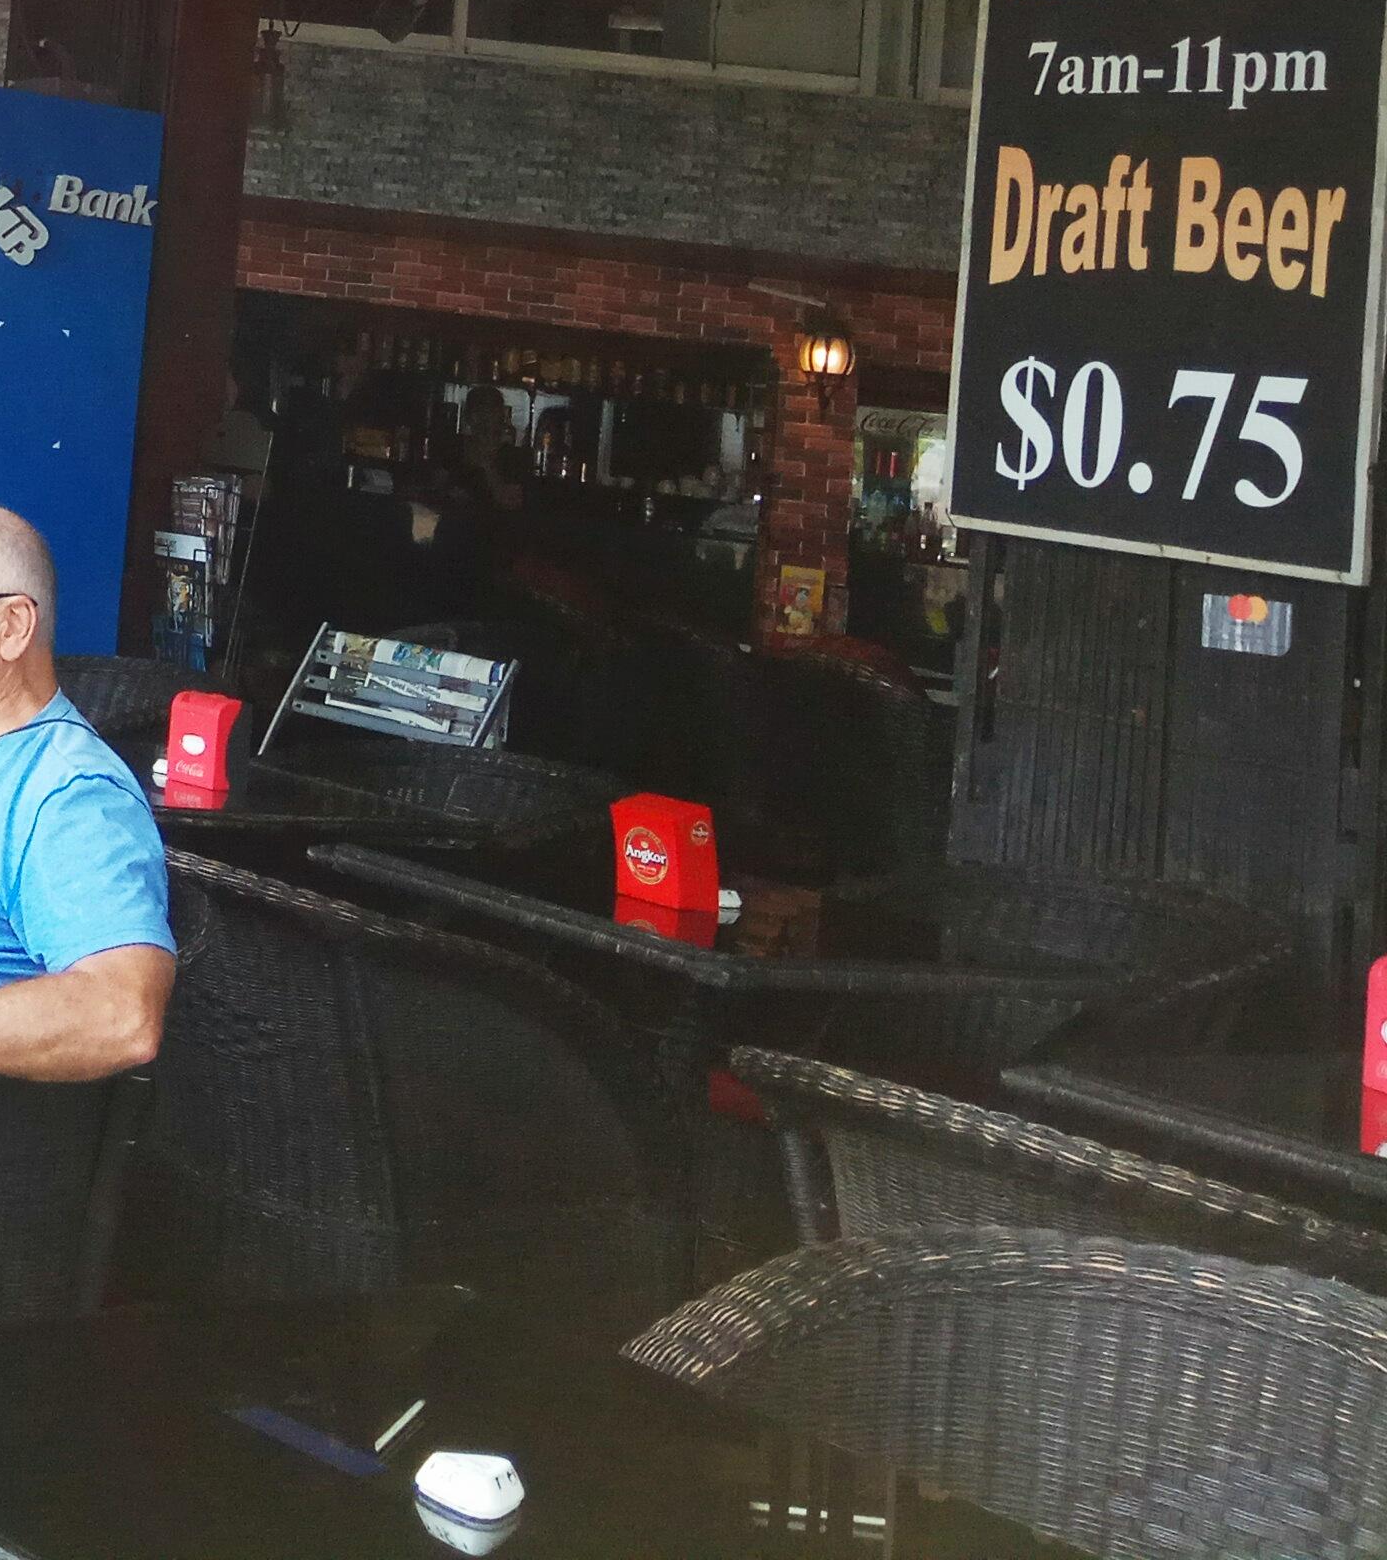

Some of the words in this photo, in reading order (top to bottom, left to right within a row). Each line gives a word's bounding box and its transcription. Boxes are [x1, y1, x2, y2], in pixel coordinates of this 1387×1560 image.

[1028, 36, 1328, 110] 7am-11pm
[48, 174, 159, 226] Bank
[988, 145, 1152, 285] Draft
[1173, 156, 1346, 298] Beer
[995, 355, 1308, 508] $0.75
[626, 844, 667, 865] Angkor
